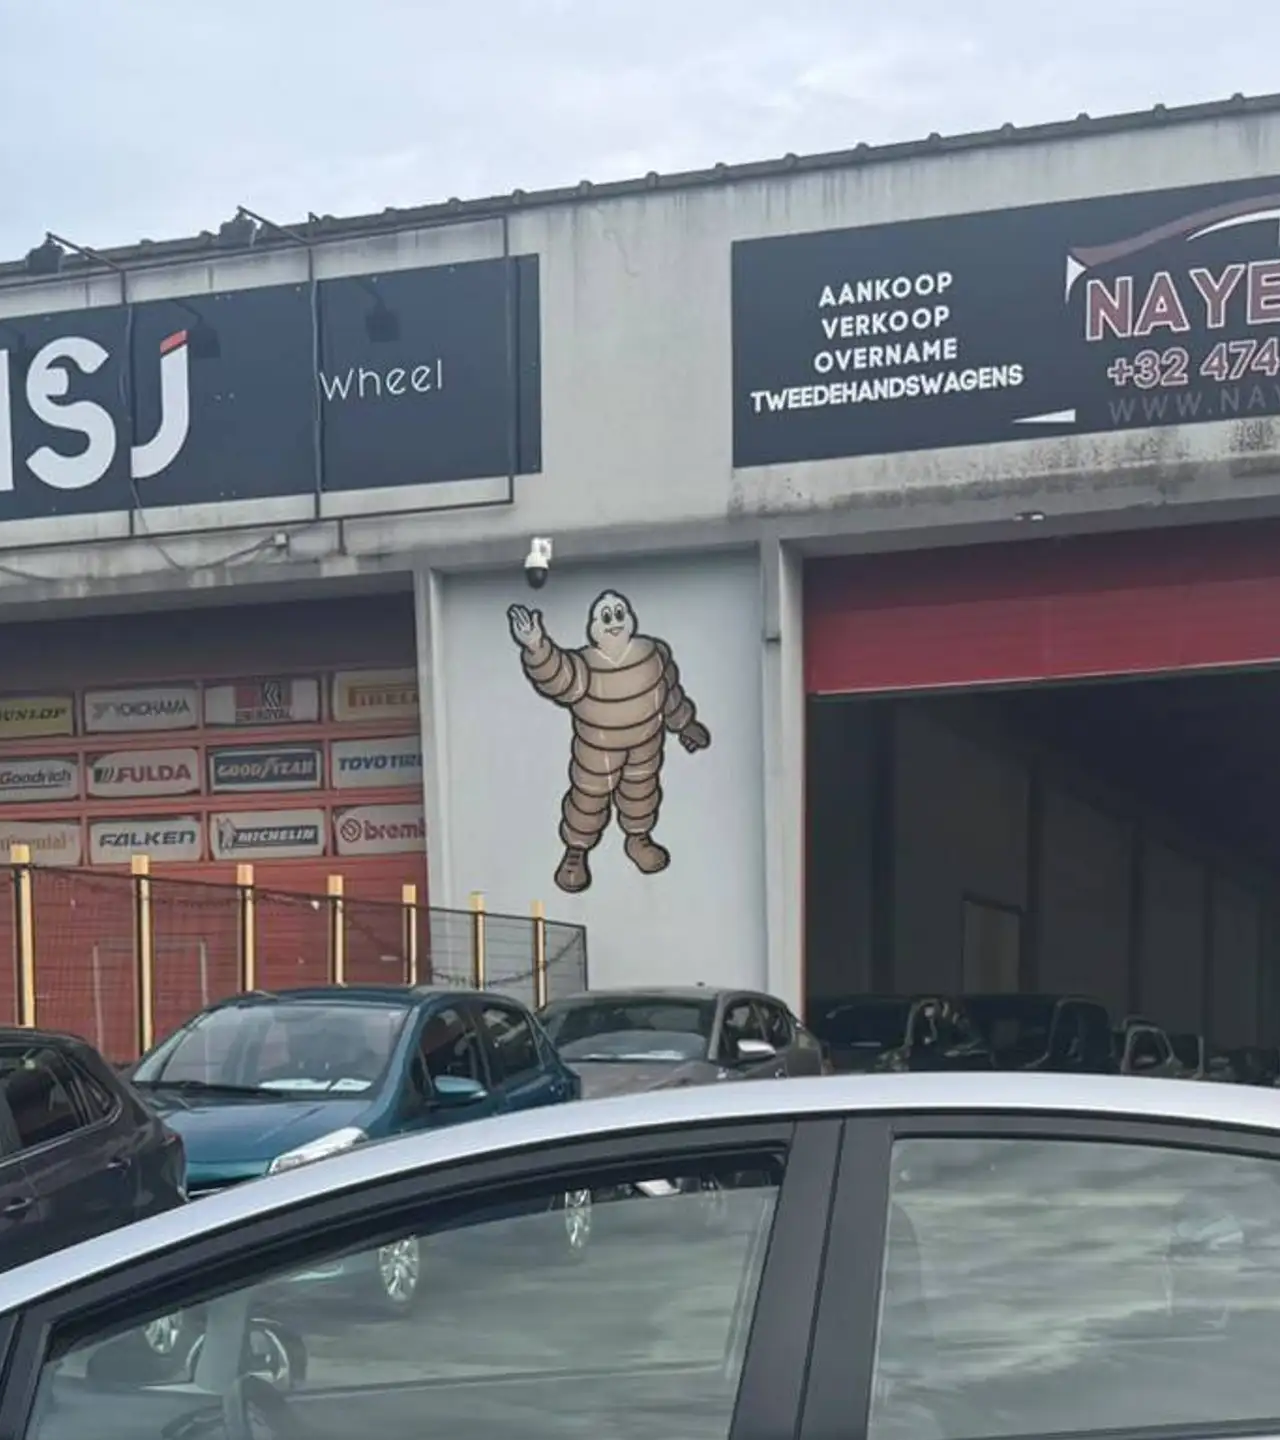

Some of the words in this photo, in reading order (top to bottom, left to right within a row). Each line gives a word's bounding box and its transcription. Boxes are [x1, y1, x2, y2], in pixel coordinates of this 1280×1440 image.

[819, 271, 954, 308] AANKOOP
[822, 306, 950, 340] VERKOOP
[814, 337, 958, 374] OVERNAME
[1106, 347, 1189, 389] +32
[1200, 337, 1280, 382] 474
[319, 358, 443, 402] Wheel
[750, 364, 1024, 413] TWEEDEHANDSWAGENS
[114, 764, 192, 784] FULDA
[217, 756, 314, 778] GOODYEAR
[99, 830, 196, 848] FALKEN
[238, 828, 316, 843] MICHELIN
